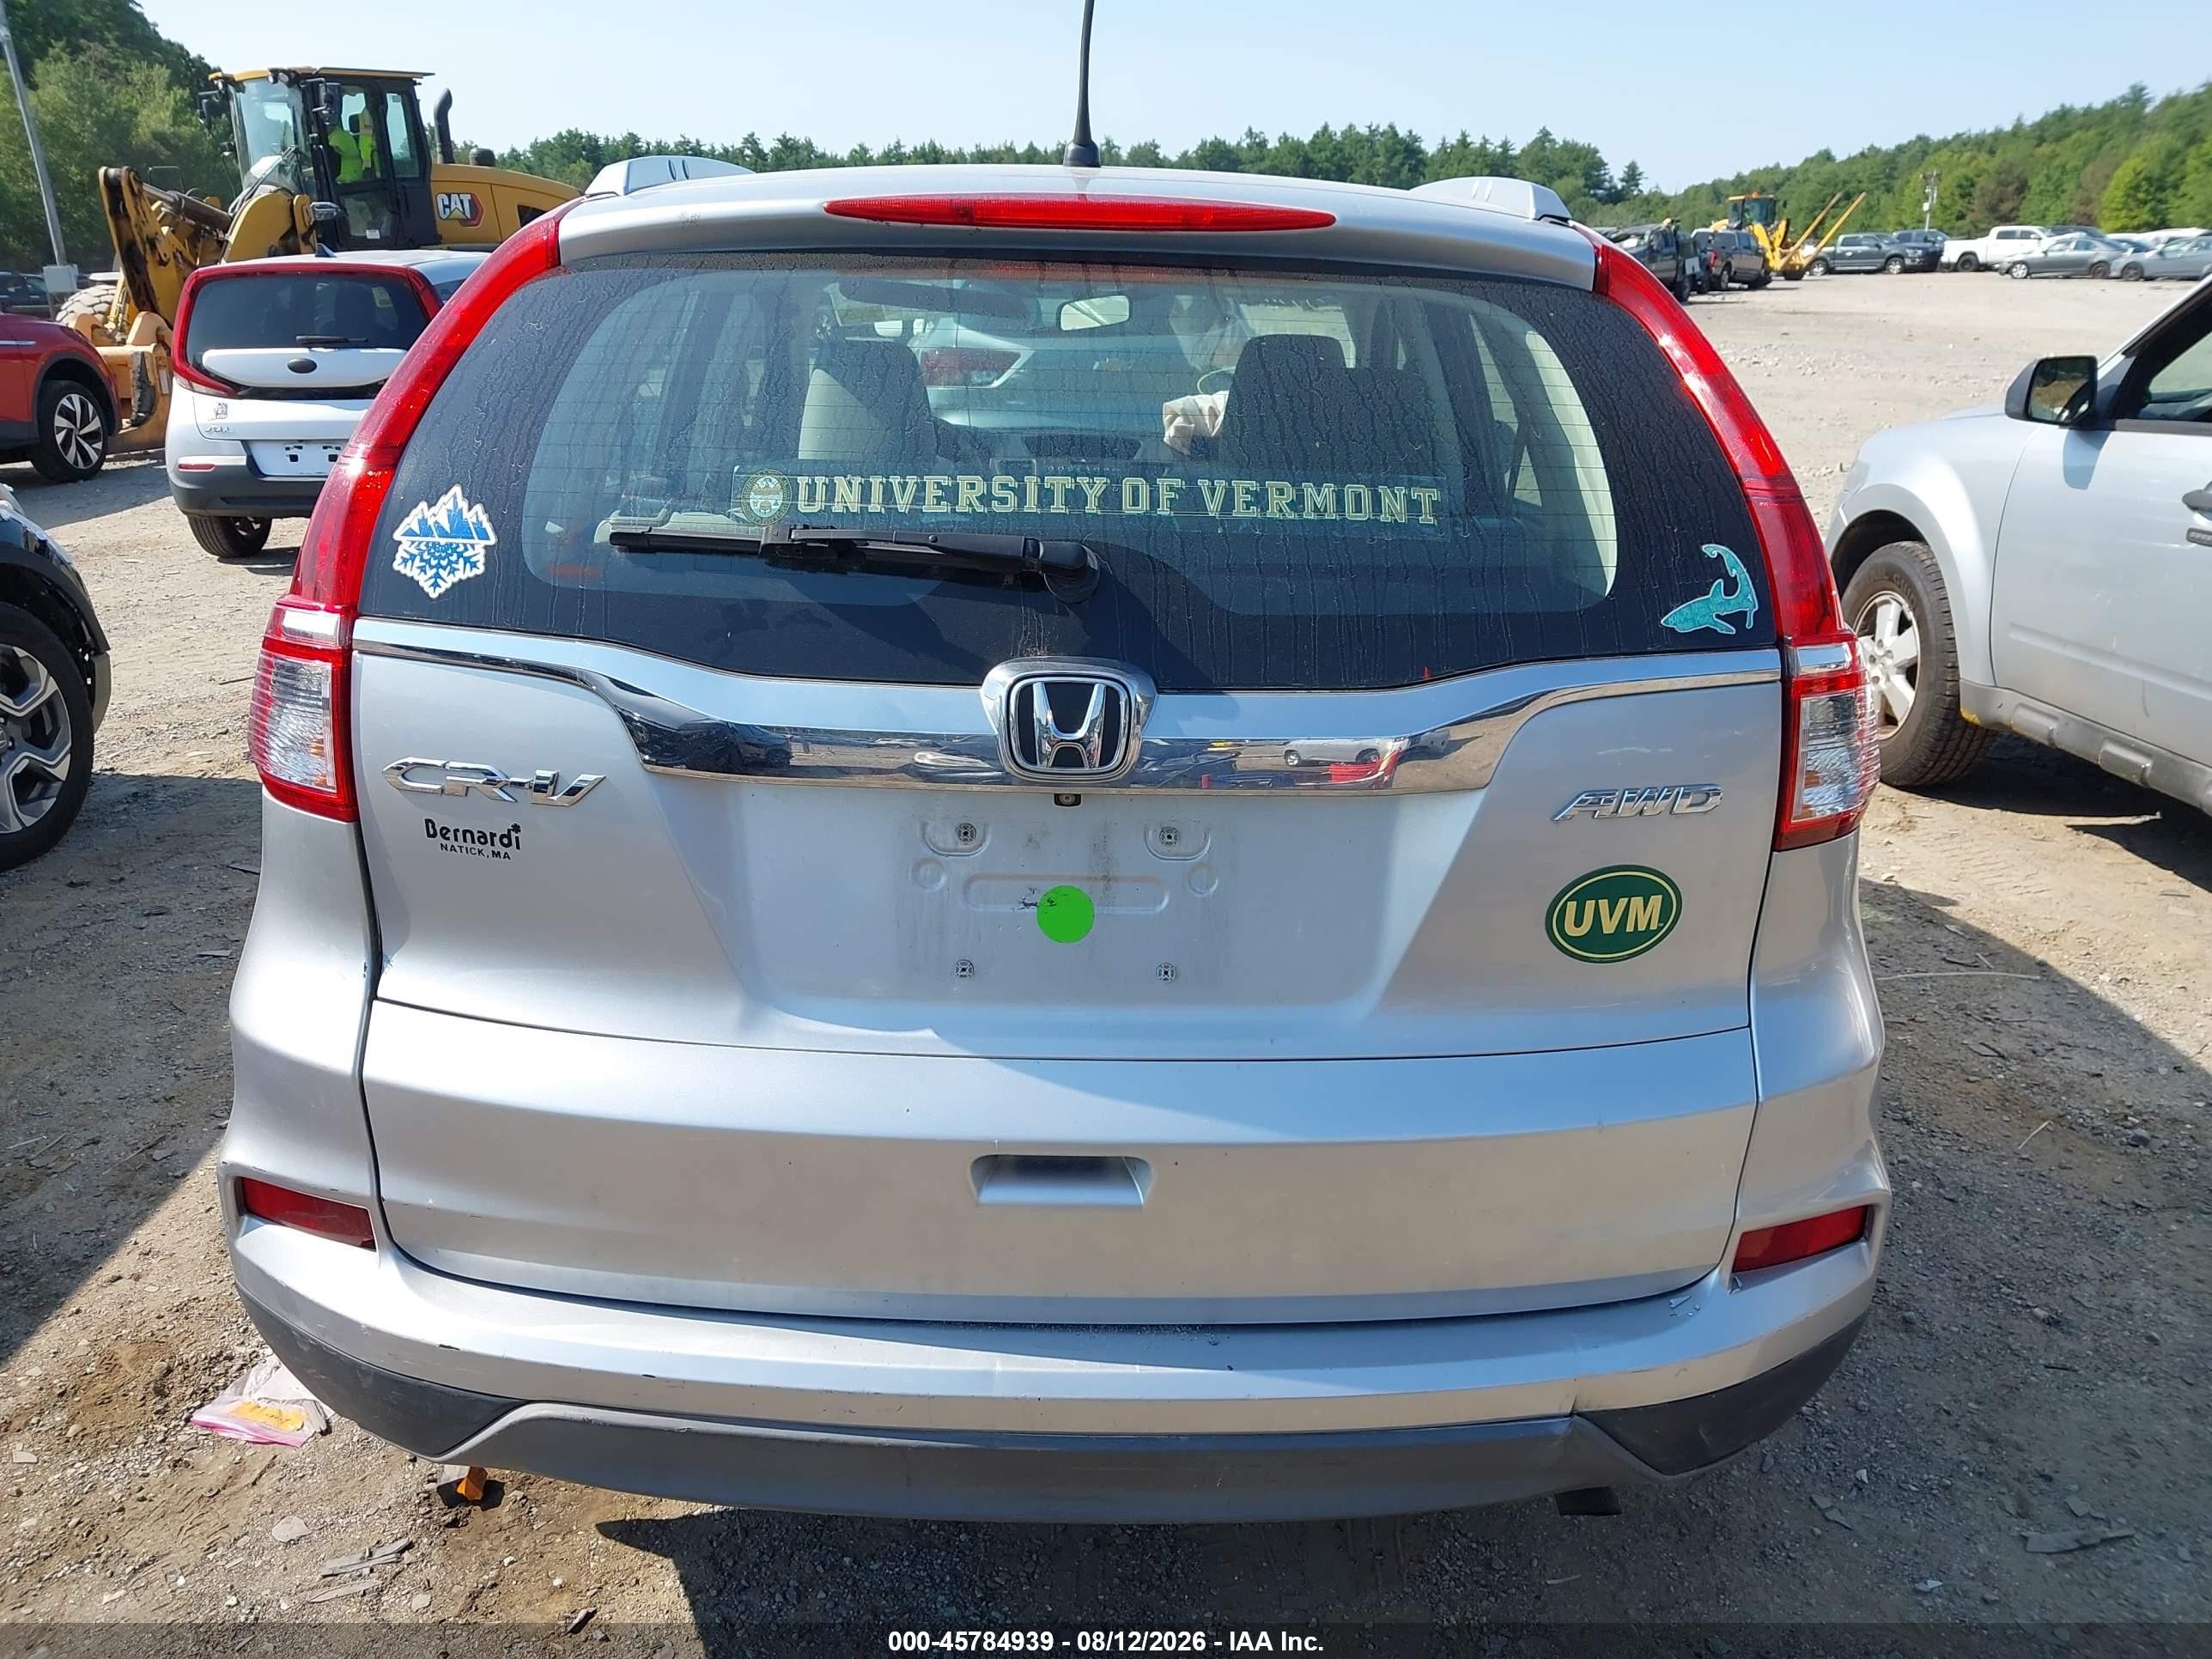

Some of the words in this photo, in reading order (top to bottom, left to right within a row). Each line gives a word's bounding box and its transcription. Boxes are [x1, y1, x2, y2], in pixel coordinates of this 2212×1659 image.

[436, 193, 471, 220] CAT
[797, 475, 1108, 515] UNIVERSITY
[1121, 477, 1185, 516] OF
[1197, 478, 1442, 526] VERMONT
[382, 757, 606, 807] CR-V
[1551, 783, 1723, 822] AWD
[424, 818, 521, 850] Bernardi
[1564, 894, 1663, 937] UVM
